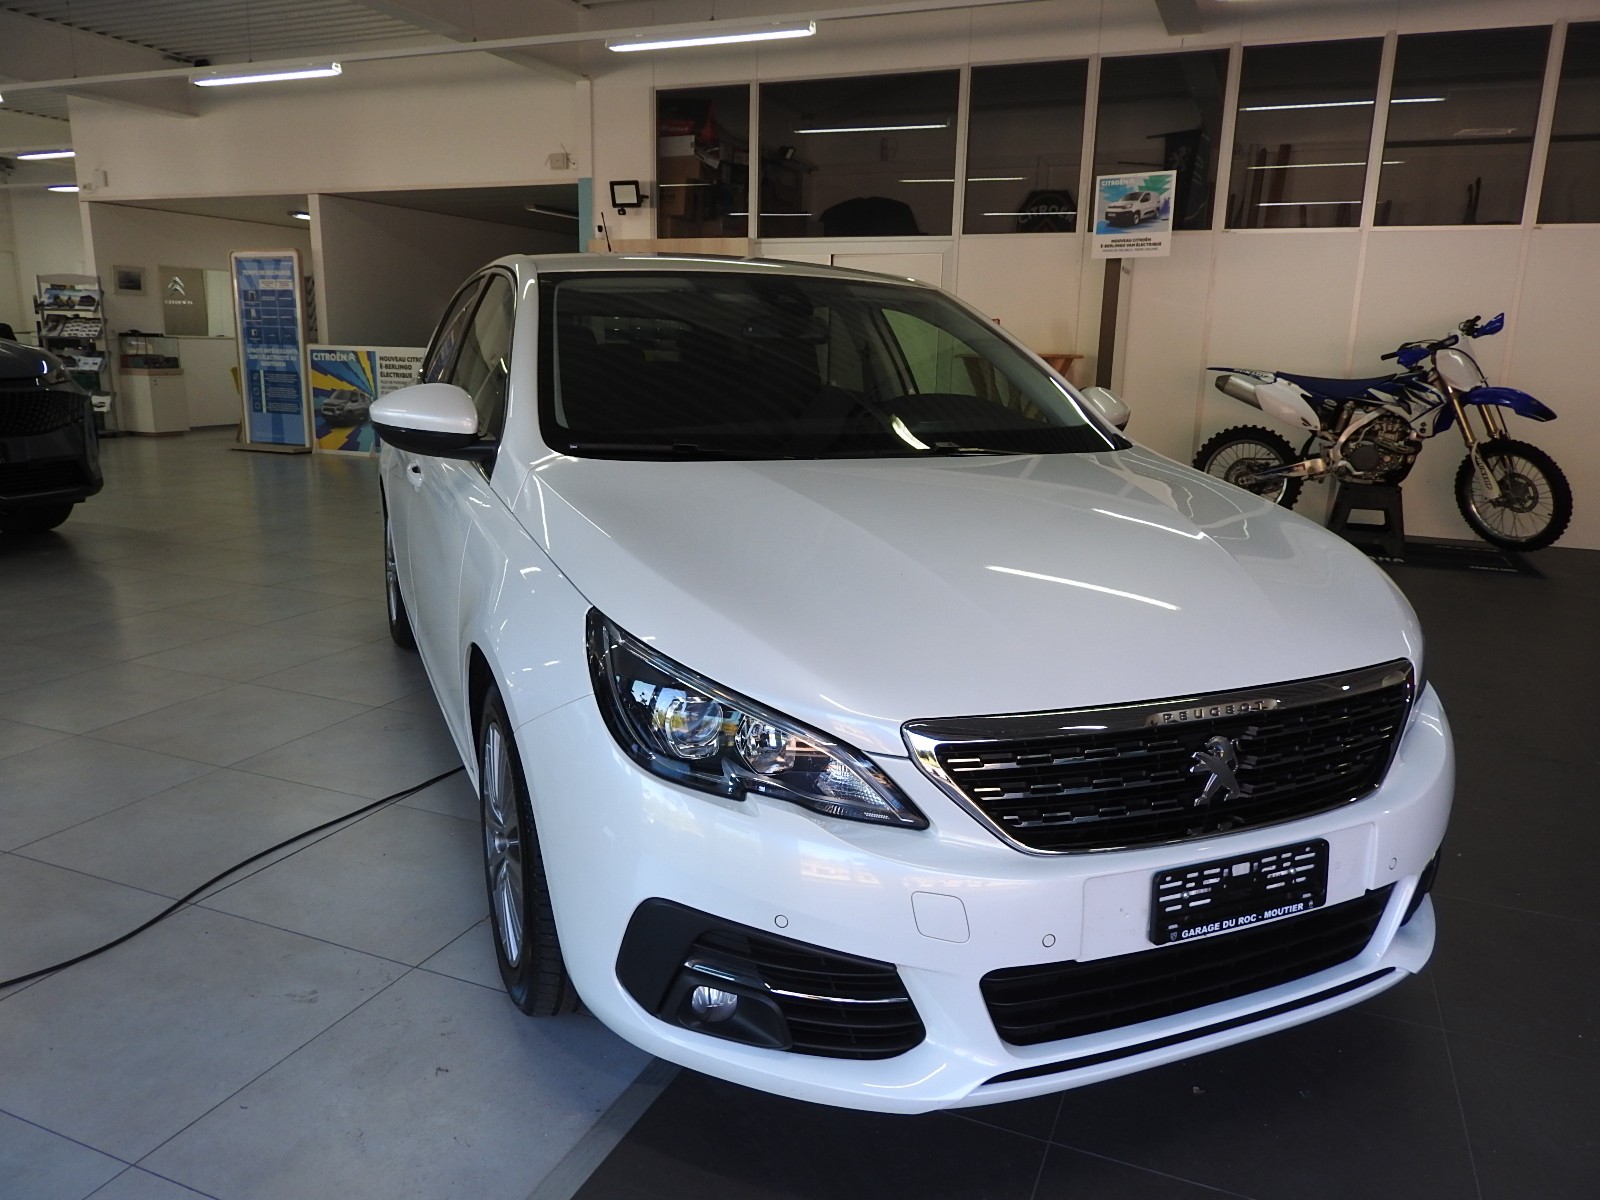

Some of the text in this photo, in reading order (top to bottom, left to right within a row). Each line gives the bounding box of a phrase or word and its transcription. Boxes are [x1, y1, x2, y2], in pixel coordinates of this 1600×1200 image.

[312, 352, 347, 361] CITROËN
[380, 371, 413, 379] ÉLECTRIQUE
[1162, 700, 1265, 723] PEUGEOT
[1181, 921, 1221, 939] GARAGE
[1222, 918, 1236, 928] DU
[1237, 914, 1257, 926] ROC
[1263, 902, 1304, 920] MOUTIER
